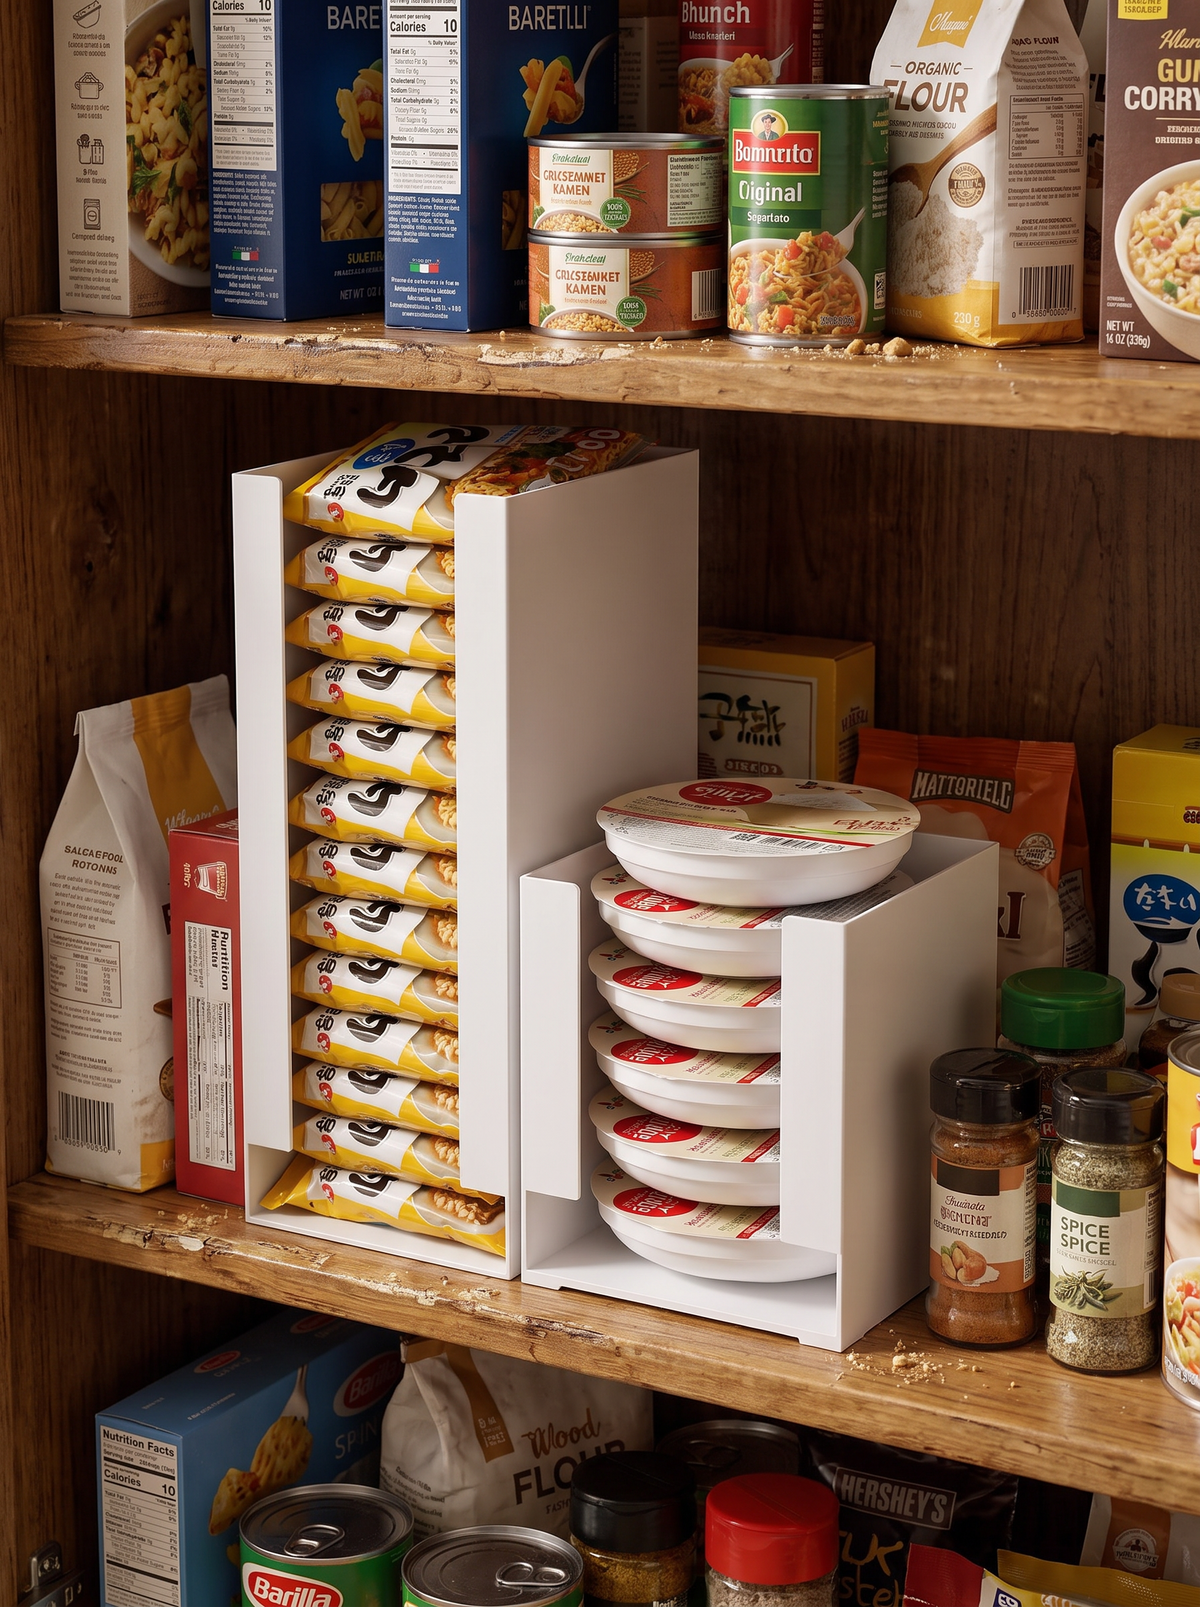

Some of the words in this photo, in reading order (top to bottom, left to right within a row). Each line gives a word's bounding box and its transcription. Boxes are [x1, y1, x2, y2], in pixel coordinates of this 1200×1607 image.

[212, 0, 245, 11] Calories
[259, 0, 272, 11] 10
[681, 0, 751, 24] Bhunch
[390, 20, 427, 32] Calories
[444, 18, 458, 33] 10
[904, 61, 962, 76] ORGANIC
[553, 183, 590, 196] KAMEN
[566, 283, 606, 296] KAMEN
[953, 310, 972, 324] 230
[973, 315, 980, 328] g
[1106, 319, 1121, 332] NET
[1121, 320, 1135, 333] WT
[1060, 1216, 1111, 1239] SPICE
[1060, 1233, 1111, 1256] SPICE
[103, 1429, 144, 1449] Nutrition
[147, 1441, 175, 1458] Facts
[104, 1468, 142, 1487] Calories
[162, 1483, 176, 1497] 10
[841, 1473, 950, 1524] HERSHEY'S
[253, 1576, 333, 1607] Barilla
